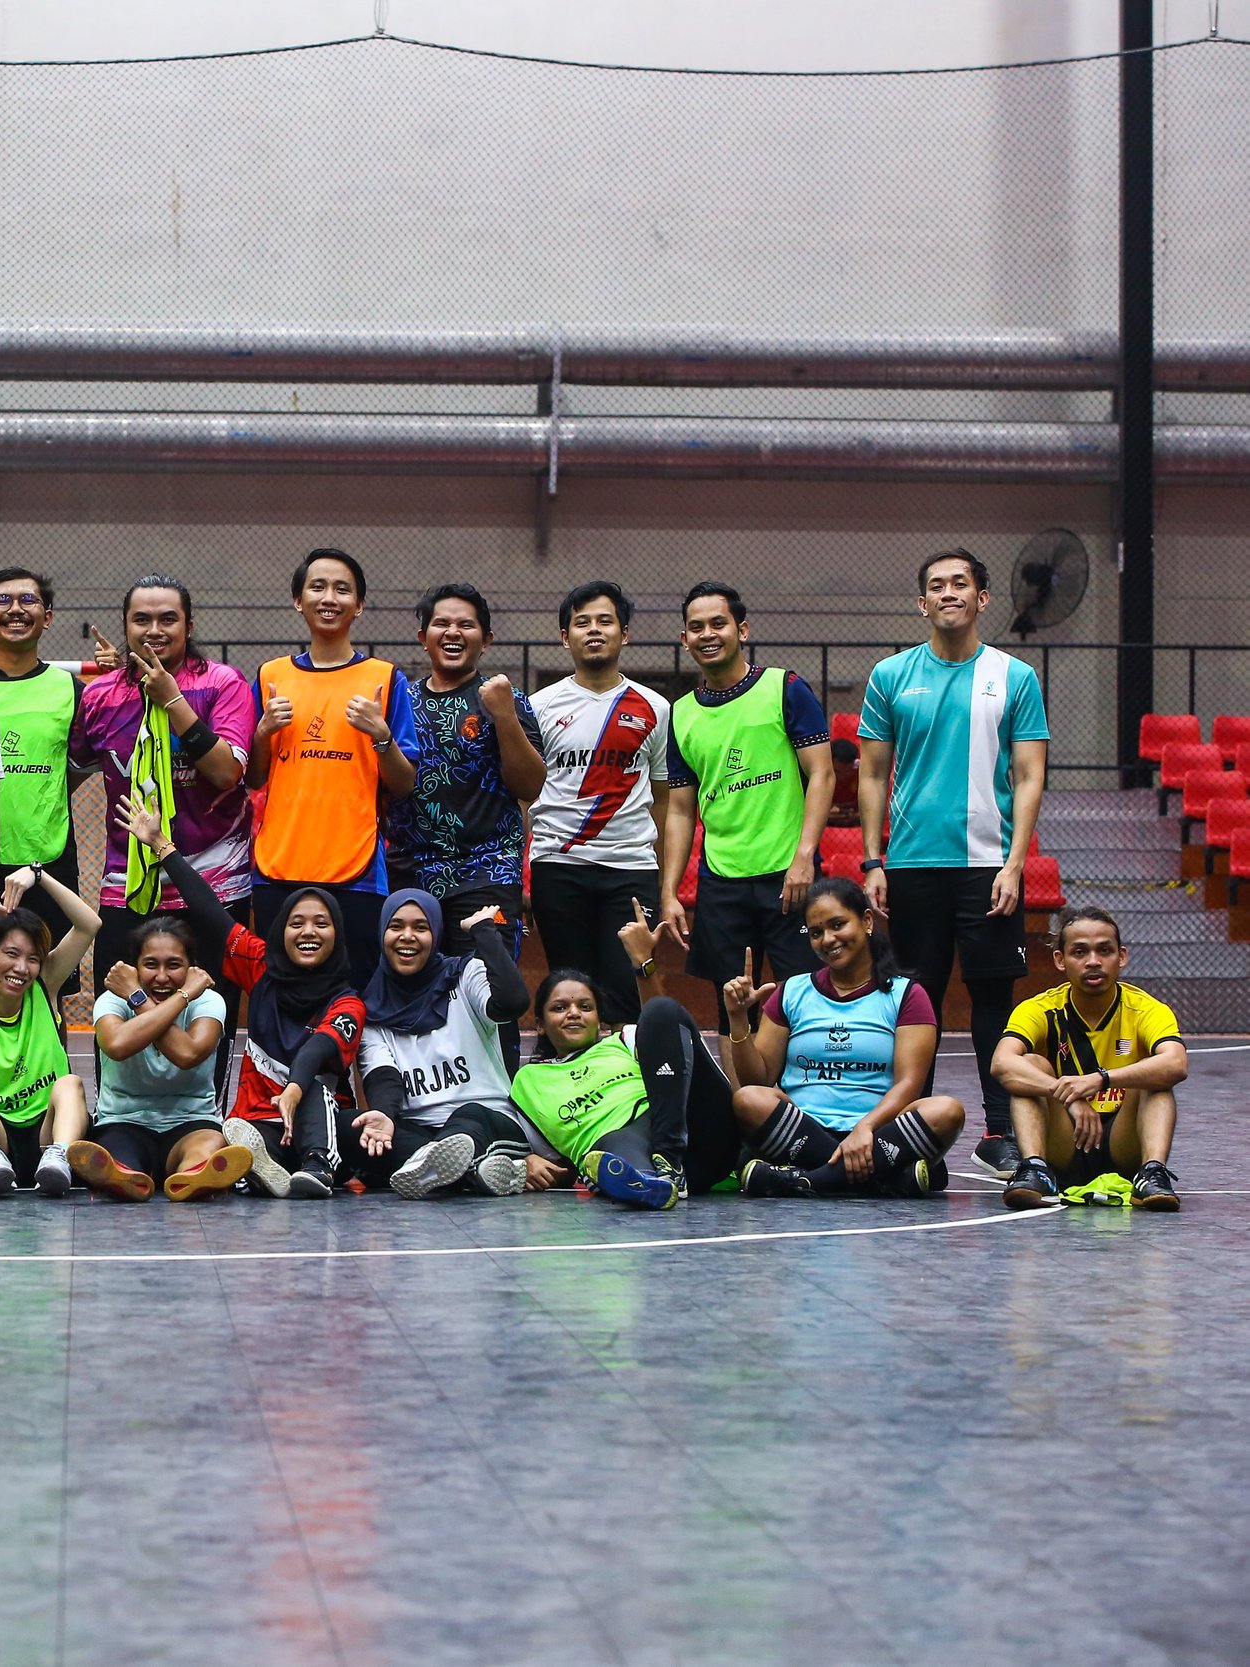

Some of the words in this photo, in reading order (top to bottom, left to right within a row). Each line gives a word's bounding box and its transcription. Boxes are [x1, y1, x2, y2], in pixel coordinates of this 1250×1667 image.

[299, 749, 353, 761] KAKIJERSI
[2, 764, 52, 774] AKIJERSI
[728, 770, 782, 794] KAKIJERSI
[332, 1014, 358, 1042] KS
[817, 1061, 886, 1072] AISKRIM
[817, 1070, 842, 1081] ALI
[5, 1071, 57, 1103] AISKRIM
